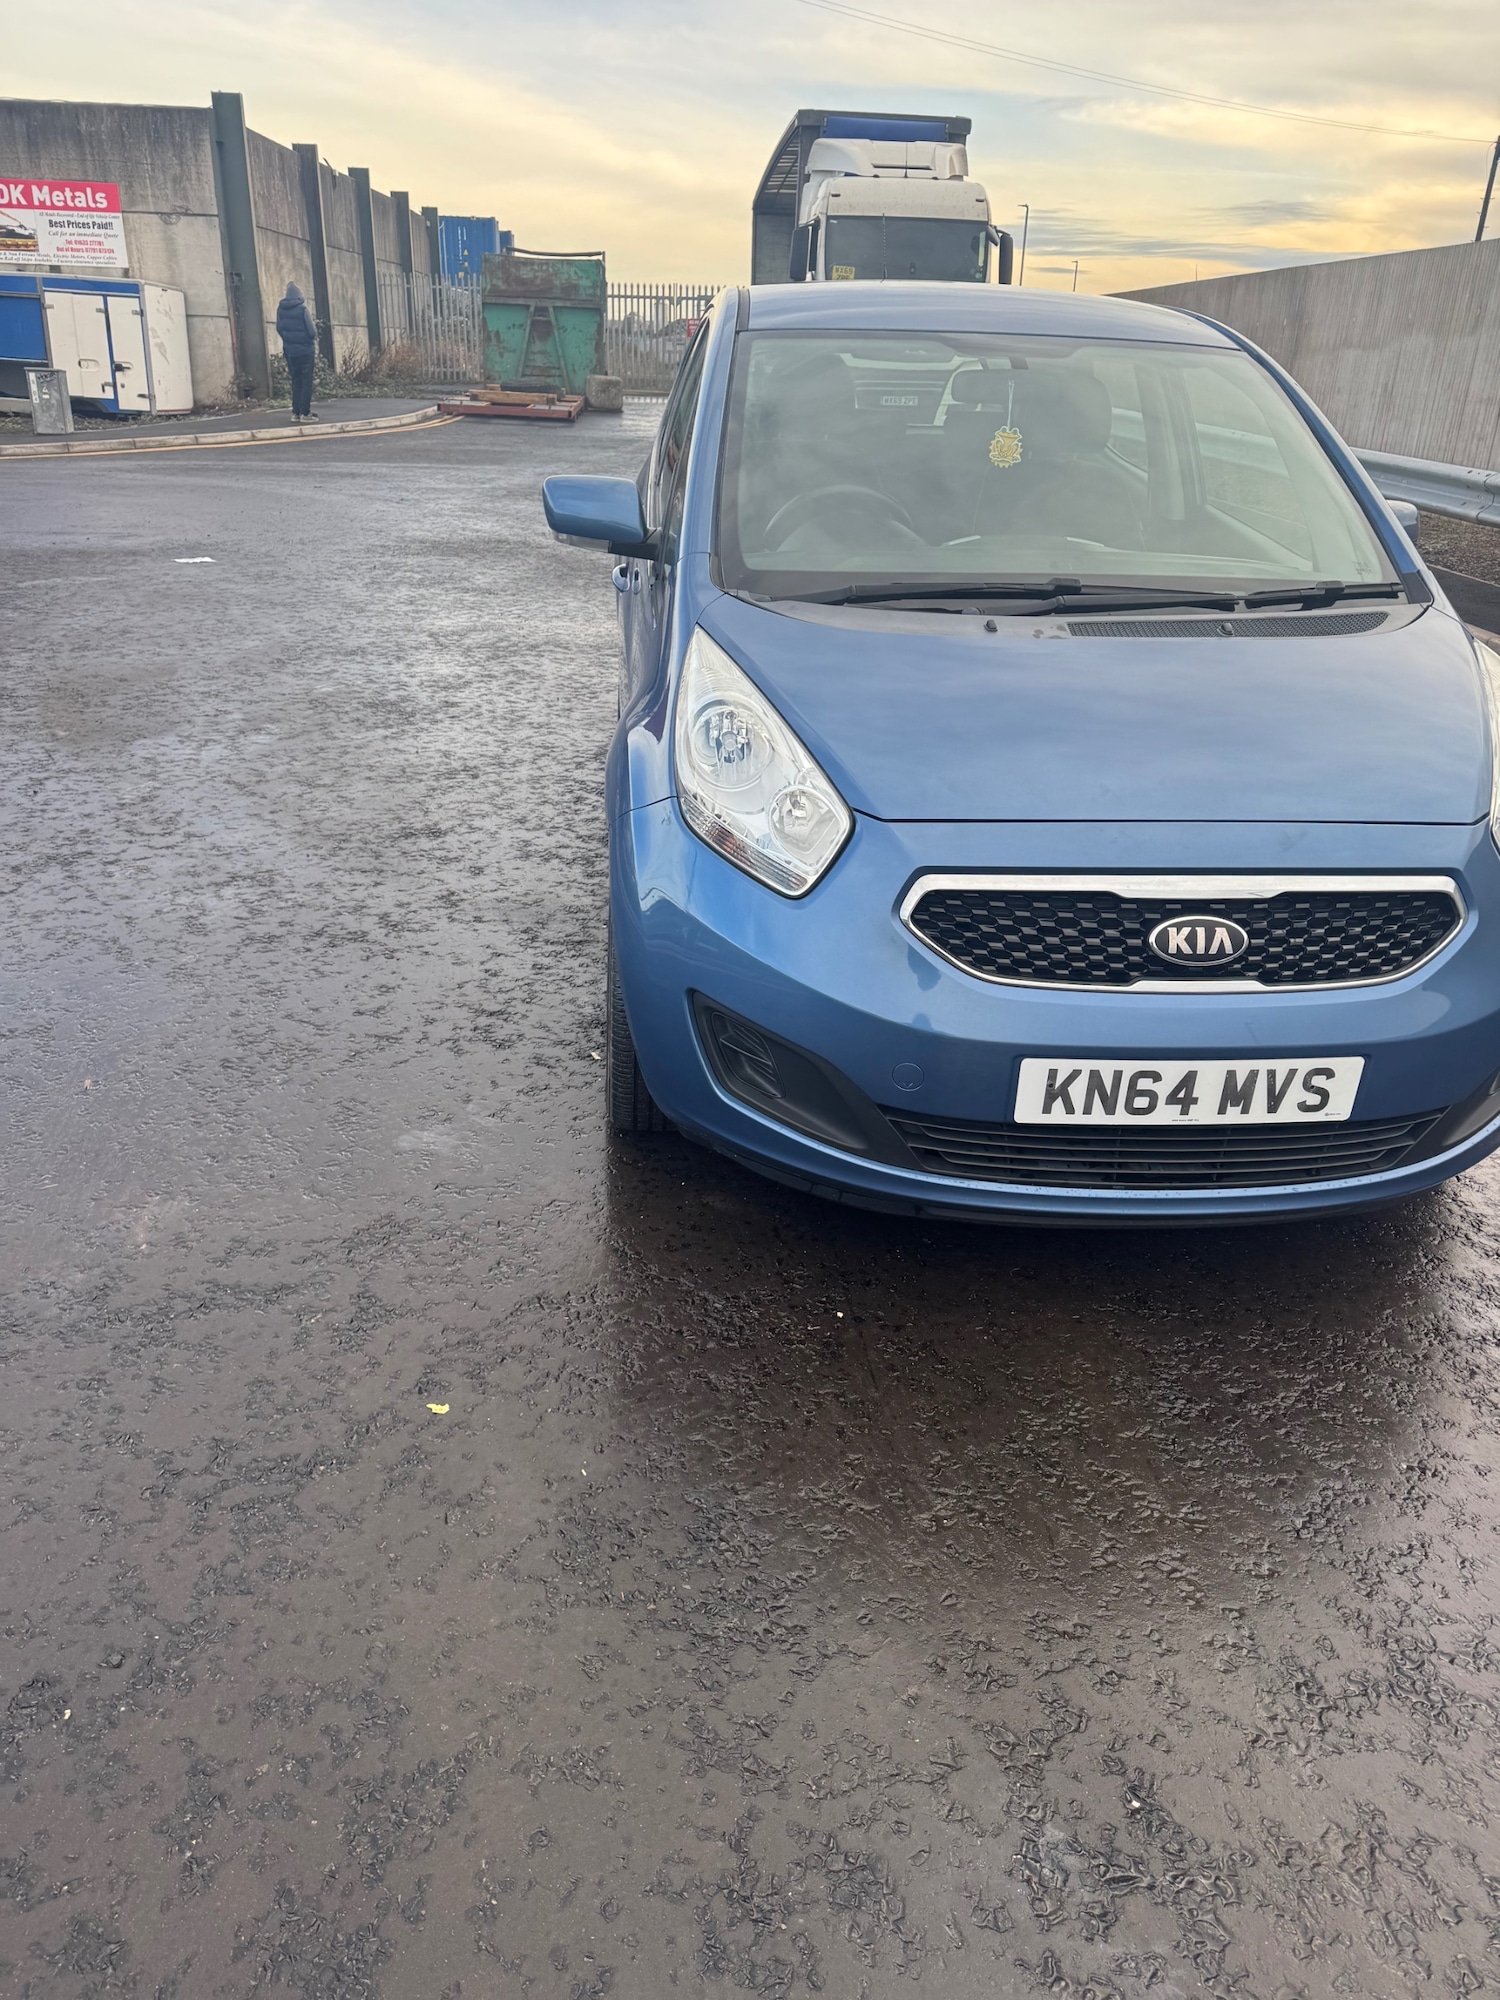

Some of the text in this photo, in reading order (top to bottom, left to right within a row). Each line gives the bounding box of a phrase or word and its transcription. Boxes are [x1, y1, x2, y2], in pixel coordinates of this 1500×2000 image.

[31, 184, 108, 208] Metals
[48, 219, 114, 230] Best Prices Paid!!
[1167, 926, 1234, 955] KIA
[1041, 1067, 1336, 1116] KN64 MVS
